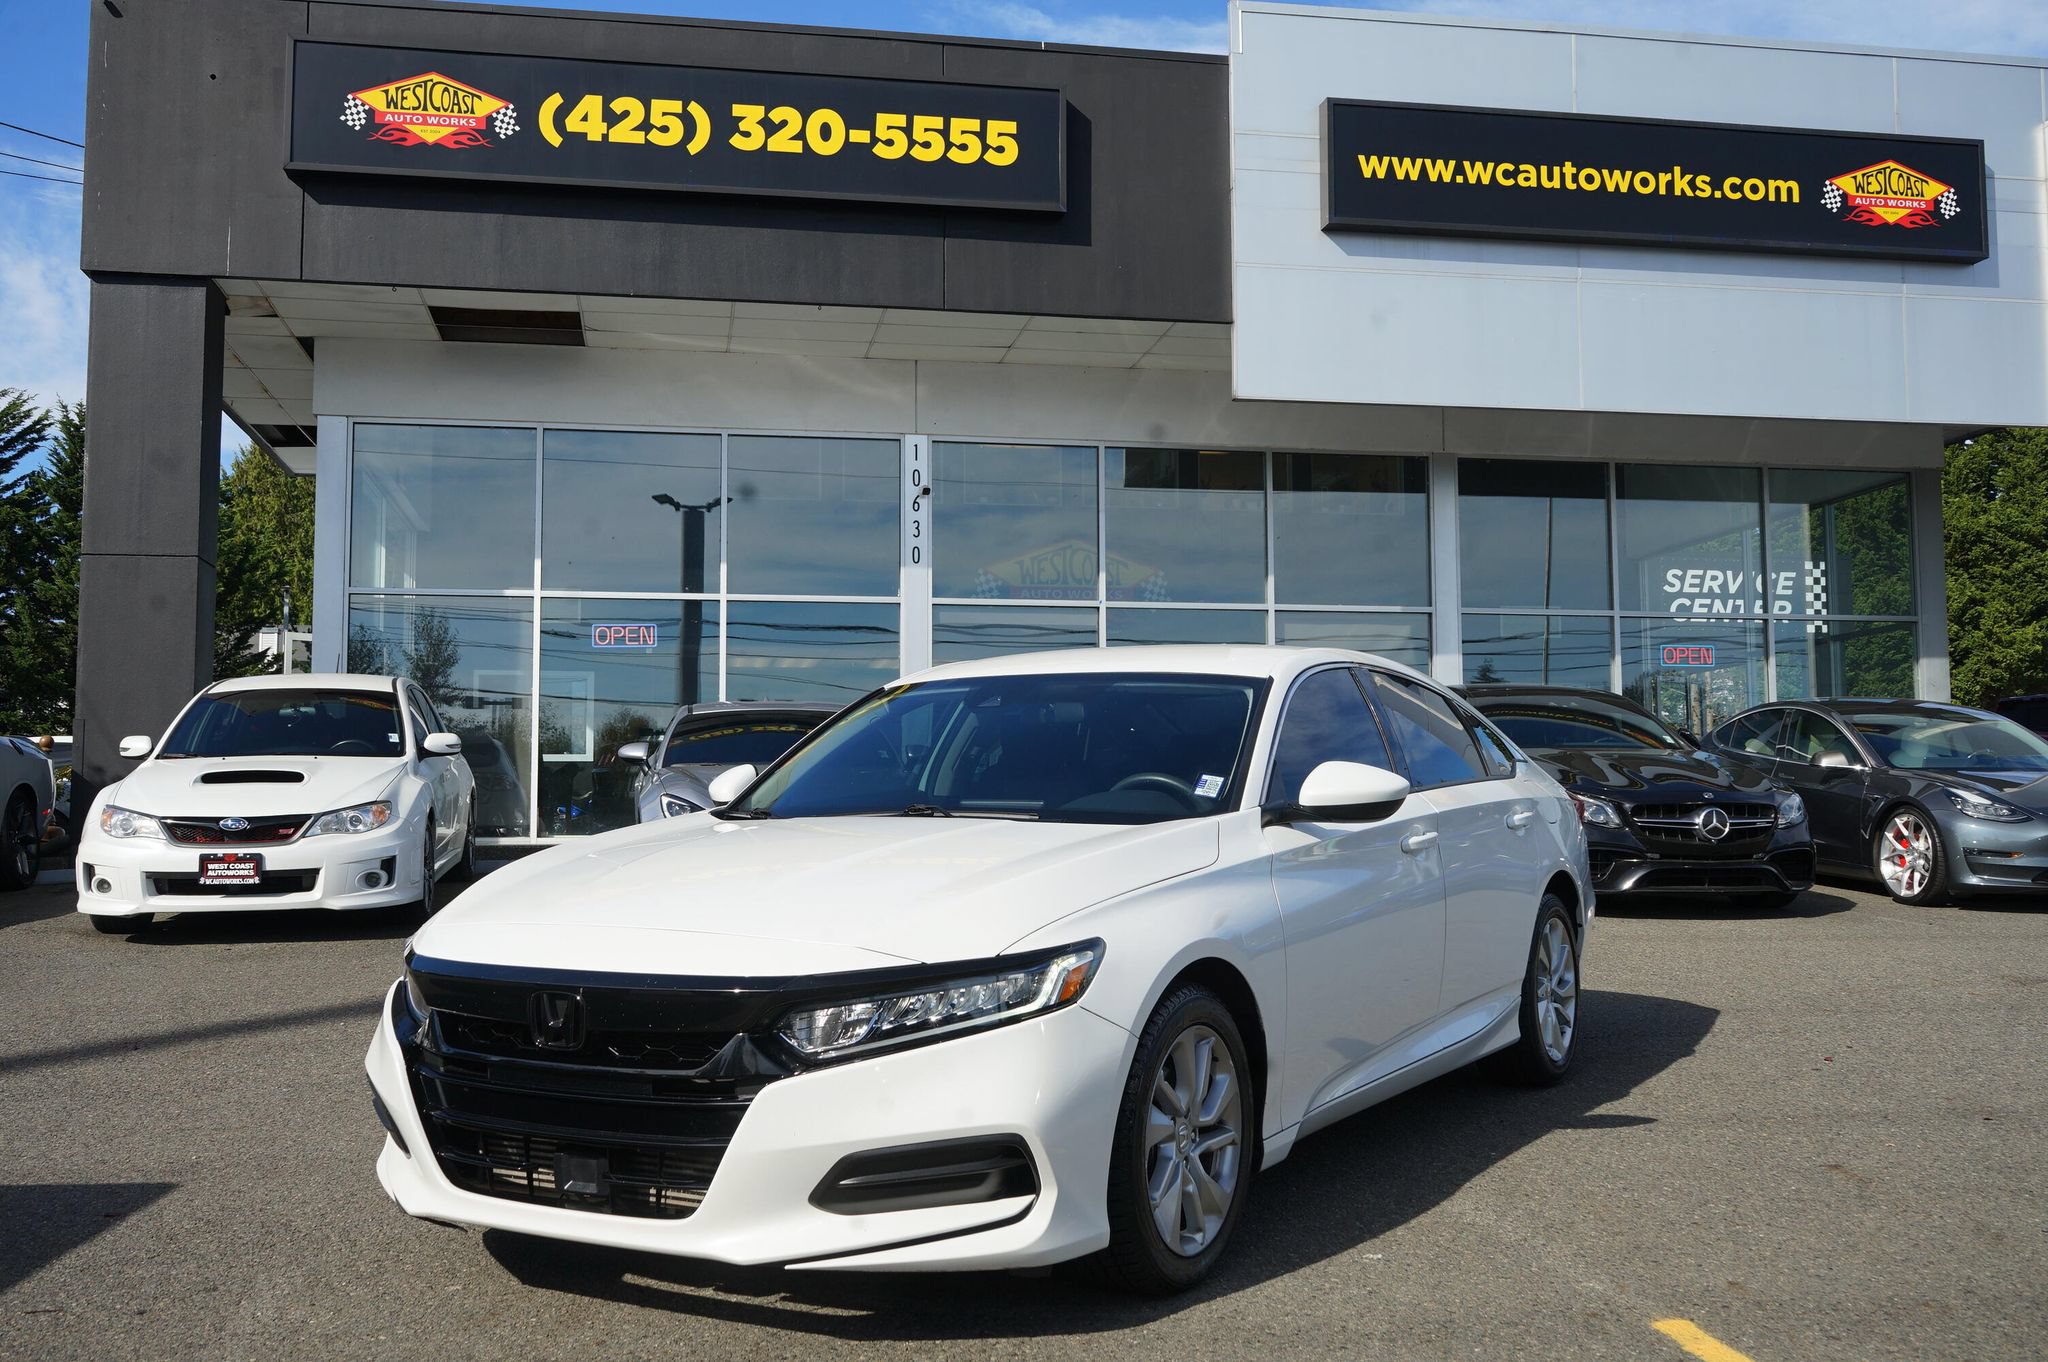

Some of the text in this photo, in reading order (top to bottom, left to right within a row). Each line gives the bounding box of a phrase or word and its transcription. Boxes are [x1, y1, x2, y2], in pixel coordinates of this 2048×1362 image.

[384, 113, 477, 127] AUTO WORKS
[538, 92, 1020, 167] (425) 320-5555
[1357, 154, 1801, 204] www.wcautoworks.com
[1855, 197, 1927, 209] AUTO WORKS
[912, 443, 921, 564] 10630
[1662, 569, 1797, 595] SERVCE
[1021, 589, 1063, 599] AUTO
[595, 626, 654, 645] OPEN
[1663, 647, 1713, 665] OPEN
